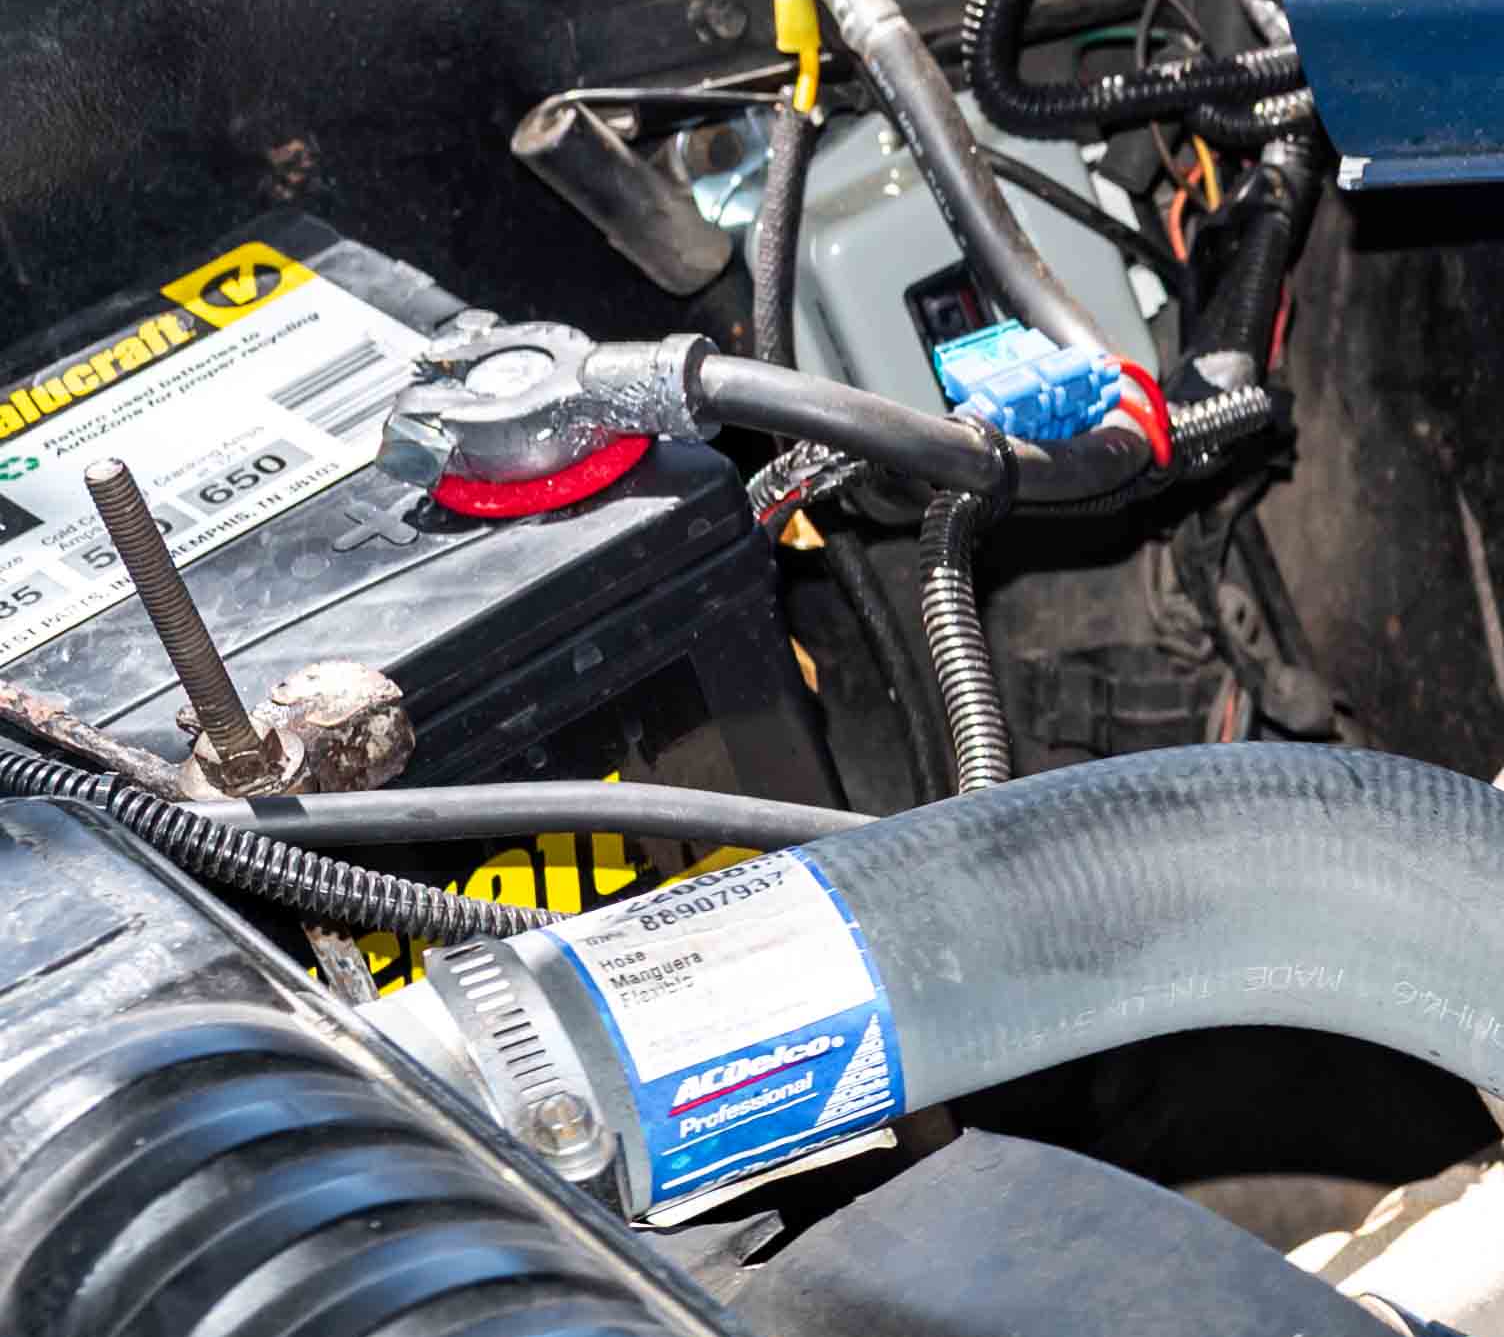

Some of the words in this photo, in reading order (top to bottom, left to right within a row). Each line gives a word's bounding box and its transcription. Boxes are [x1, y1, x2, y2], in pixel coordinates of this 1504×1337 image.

[43, 414, 108, 450] Return
[112, 386, 155, 414] used
[159, 345, 239, 389] batteries
[56, 409, 145, 457] AutoZone
[149, 389, 174, 407] for
[178, 358, 235, 395] proper
[240, 313, 321, 356] recycling
[199, 454, 287, 505] 650
[600, 949, 648, 973] Hose
[608, 950, 704, 990] Manguera
[671, 1035, 832, 1107] ACDelco
[679, 1070, 814, 1139] Professional
